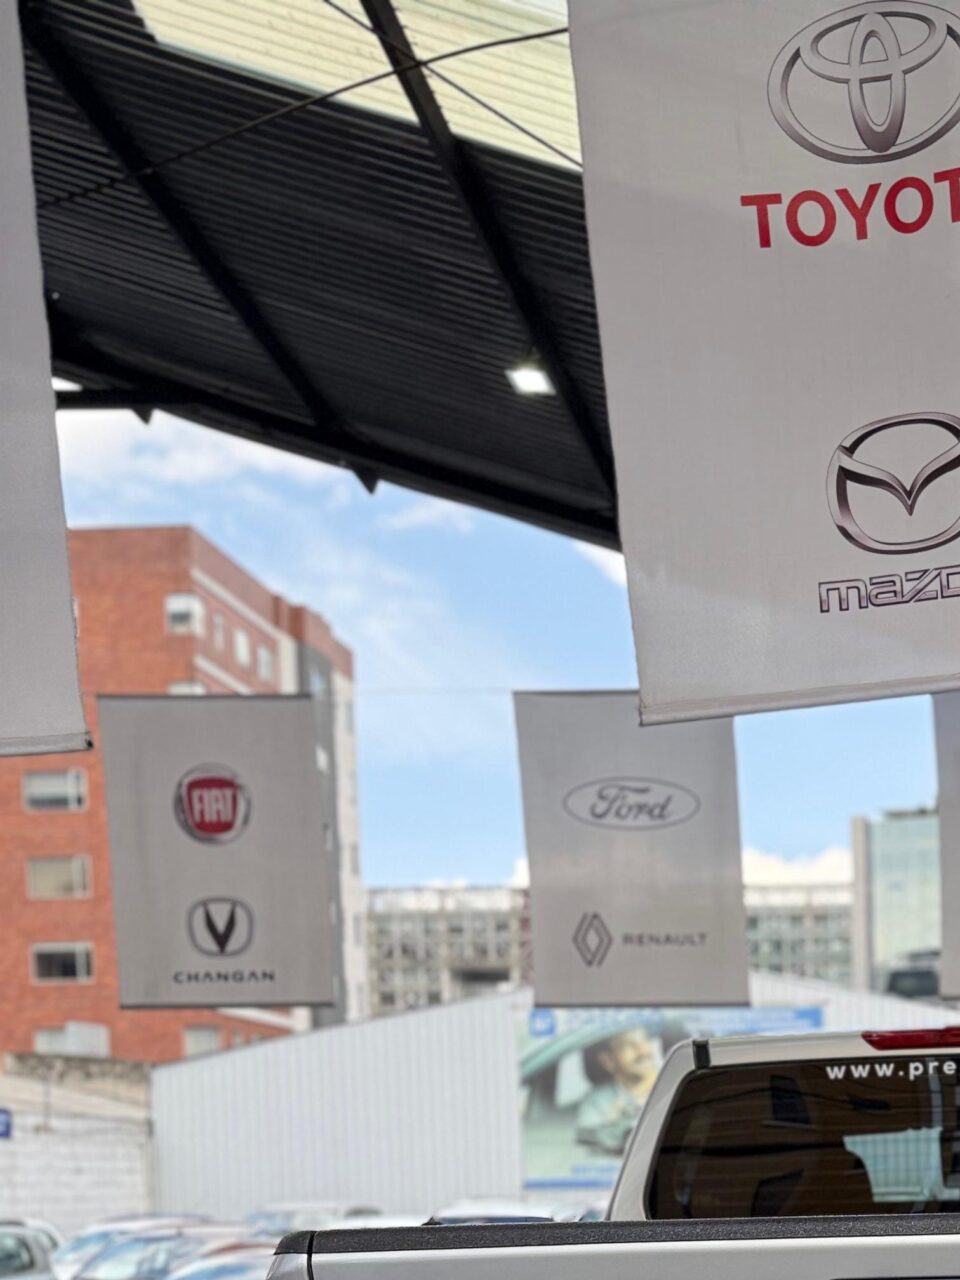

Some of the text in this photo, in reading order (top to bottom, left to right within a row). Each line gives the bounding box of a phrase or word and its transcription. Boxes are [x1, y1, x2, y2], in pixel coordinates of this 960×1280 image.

[190, 786, 235, 823] FIAT
[590, 784, 674, 821] Ford
[621, 931, 708, 948] RENAULT
[172, 969, 276, 985] CHANGAN
